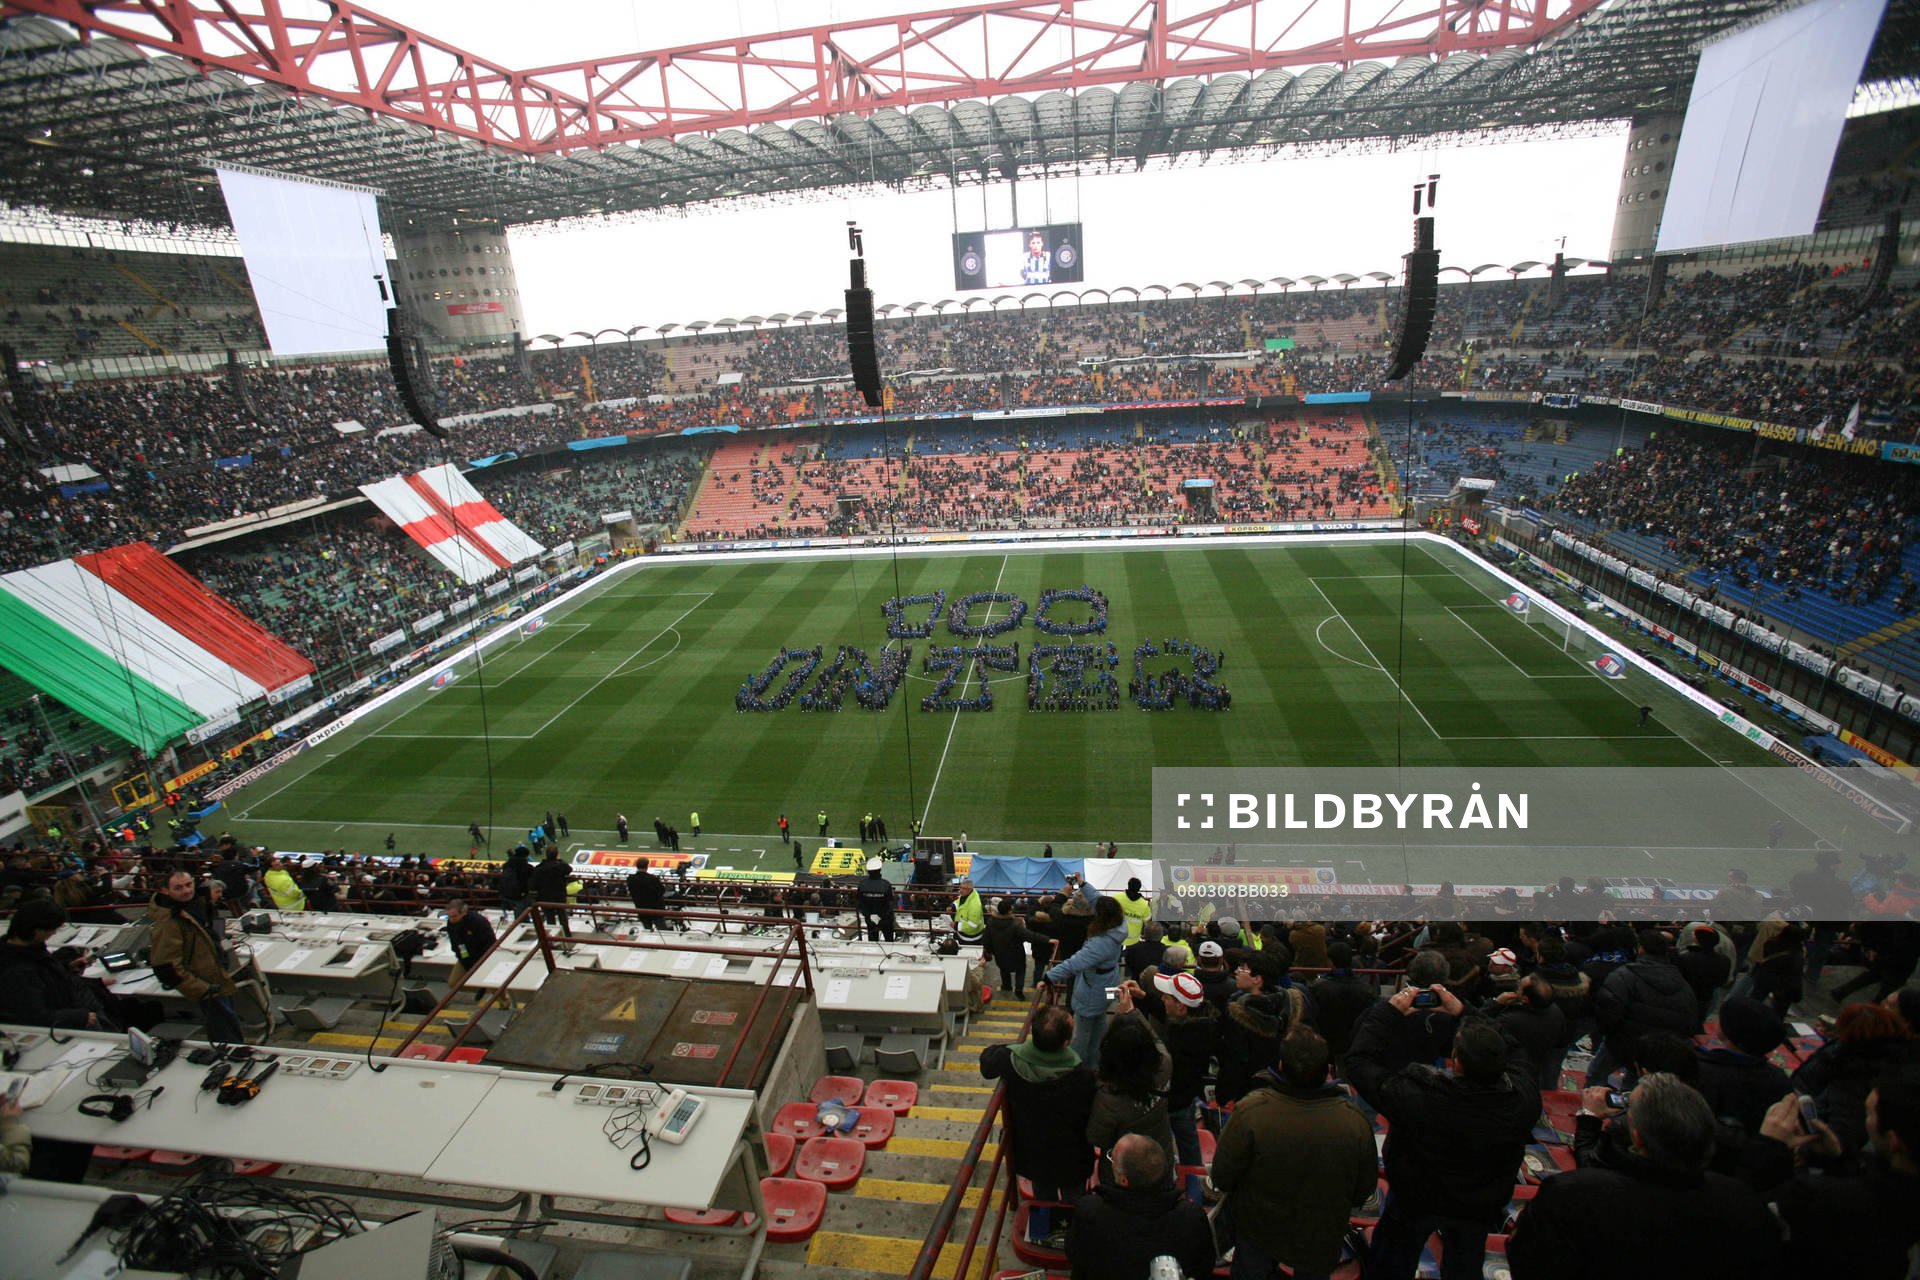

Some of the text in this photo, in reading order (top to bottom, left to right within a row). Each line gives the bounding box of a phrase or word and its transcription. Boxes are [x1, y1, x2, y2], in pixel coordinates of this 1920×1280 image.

[1759, 421, 1797, 442] BASSO
[1794, 653, 1824, 674] Estero
[1856, 681, 1886, 703] Puga
[310, 720, 345, 744] expert
[1771, 741, 1874, 813] NIKEFOOTBALL.COM
[1193, 867, 1311, 884] PIRELLI
[1299, 884, 1401, 896] BIRRA MORETTI
